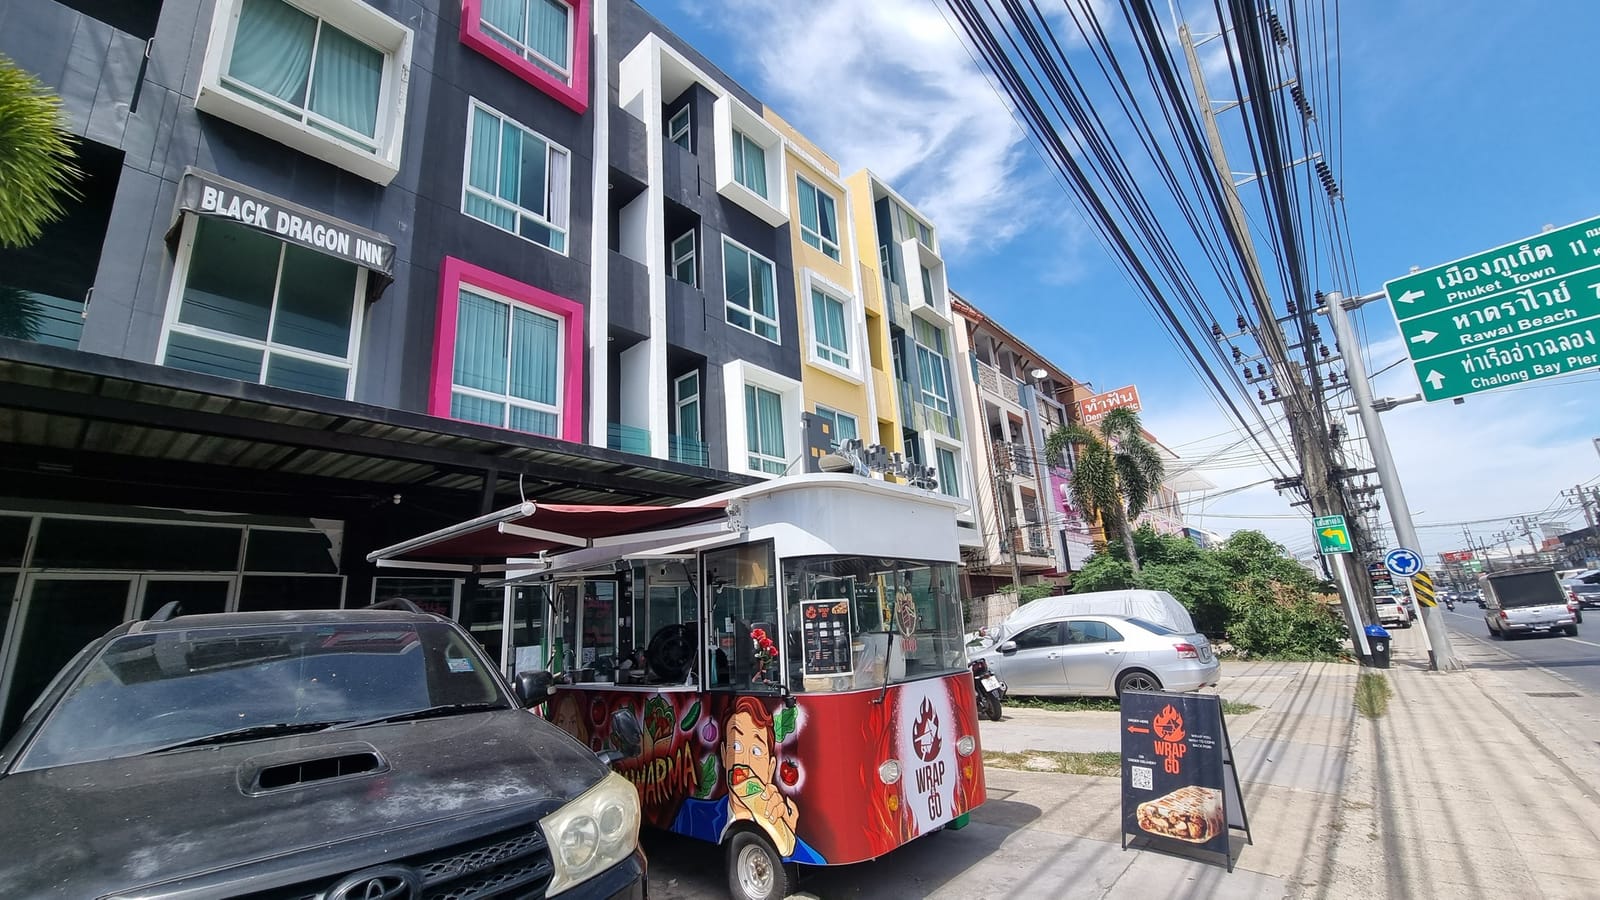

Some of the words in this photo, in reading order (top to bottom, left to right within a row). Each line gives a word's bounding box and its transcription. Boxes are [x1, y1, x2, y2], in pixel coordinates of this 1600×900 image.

[201, 186, 270, 229] BLACK
[276, 211, 349, 255] DRAGON
[355, 238, 383, 266] INN
[1436, 243, 1554, 290] เมืองภูเก็ต
[1569, 239, 1587, 256] 11
[1447, 280, 1502, 303] Phuket
[1509, 266, 1556, 285] Town
[1452, 281, 1571, 330] หาดราไวย์
[1459, 325, 1514, 345] Rawai
[1517, 308, 1578, 331] Beach
[1461, 329, 1596, 374] ท่าเรืออ่าวฉลอง
[1471, 369, 1529, 389] Chalong
[1533, 360, 1561, 377] Bay
[1566, 353, 1598, 368] Pier
[1085, 391, 1134, 413] ทำฟัน
[1154, 740, 1186, 758] WRAP
[1164, 758, 1180, 774] GO
[915, 760, 945, 794] WRAP
[927, 792, 943, 821] GO
